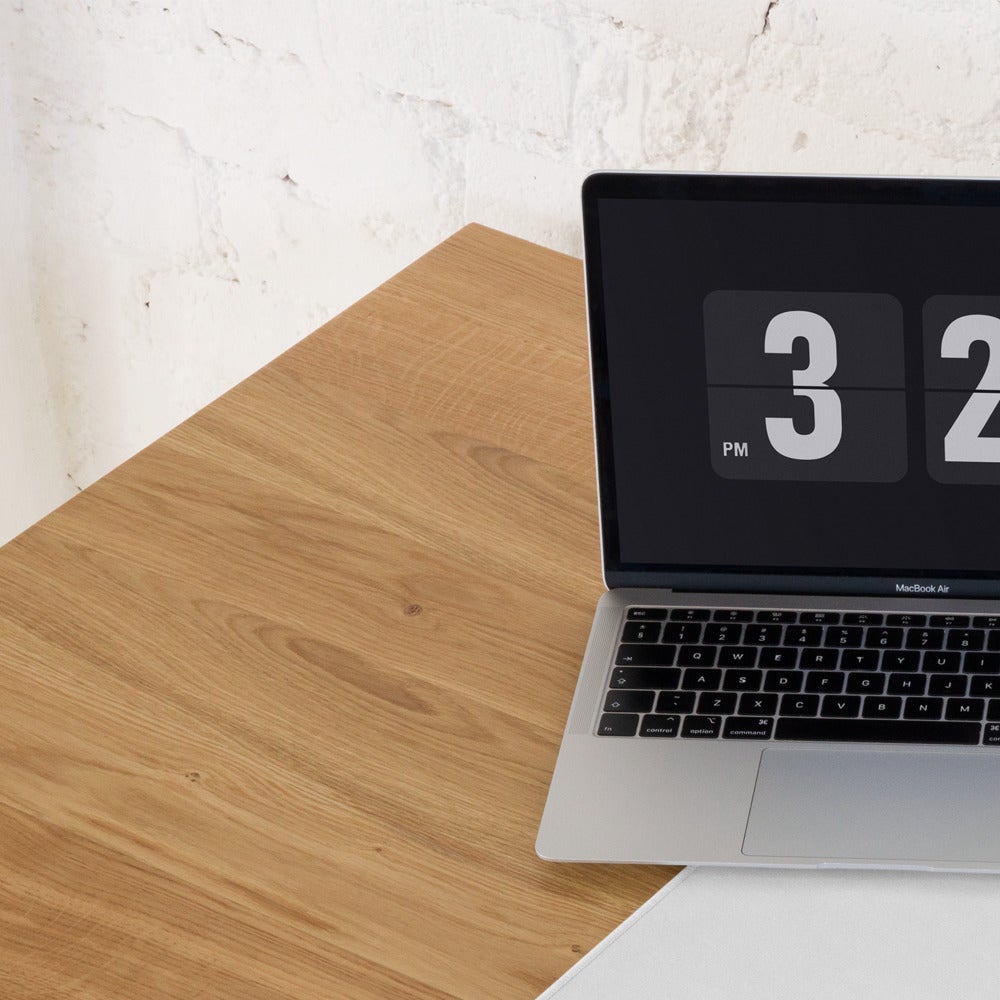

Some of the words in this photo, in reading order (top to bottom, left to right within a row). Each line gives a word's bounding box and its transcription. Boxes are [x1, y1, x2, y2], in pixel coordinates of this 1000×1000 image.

[765, 311, 842, 460] 3
[723, 441, 748, 457] PM
[895, 583, 936, 593] MacBook
[937, 584, 950, 594] Air
[692, 652, 702, 660] Q
[774, 654, 782, 662] E
[856, 656, 865, 664] T
[897, 657, 905, 665] Y
[937, 658, 946, 666] U
[697, 675, 706, 683] A
[738, 676, 747, 684] S
[779, 677, 789, 685] D
[821, 678, 829, 686] F
[861, 679, 870, 687] G
[902, 680, 912, 688] H
[944, 681, 952, 689] J
[984, 682, 993, 690] K
[713, 699, 722, 707] Z
[754, 700, 763, 708] X
[795, 701, 804, 709] C
[837, 702, 846, 710] V
[877, 703, 886, 711] B
[919, 704, 928, 712] N
[959, 705, 970, 713] M
